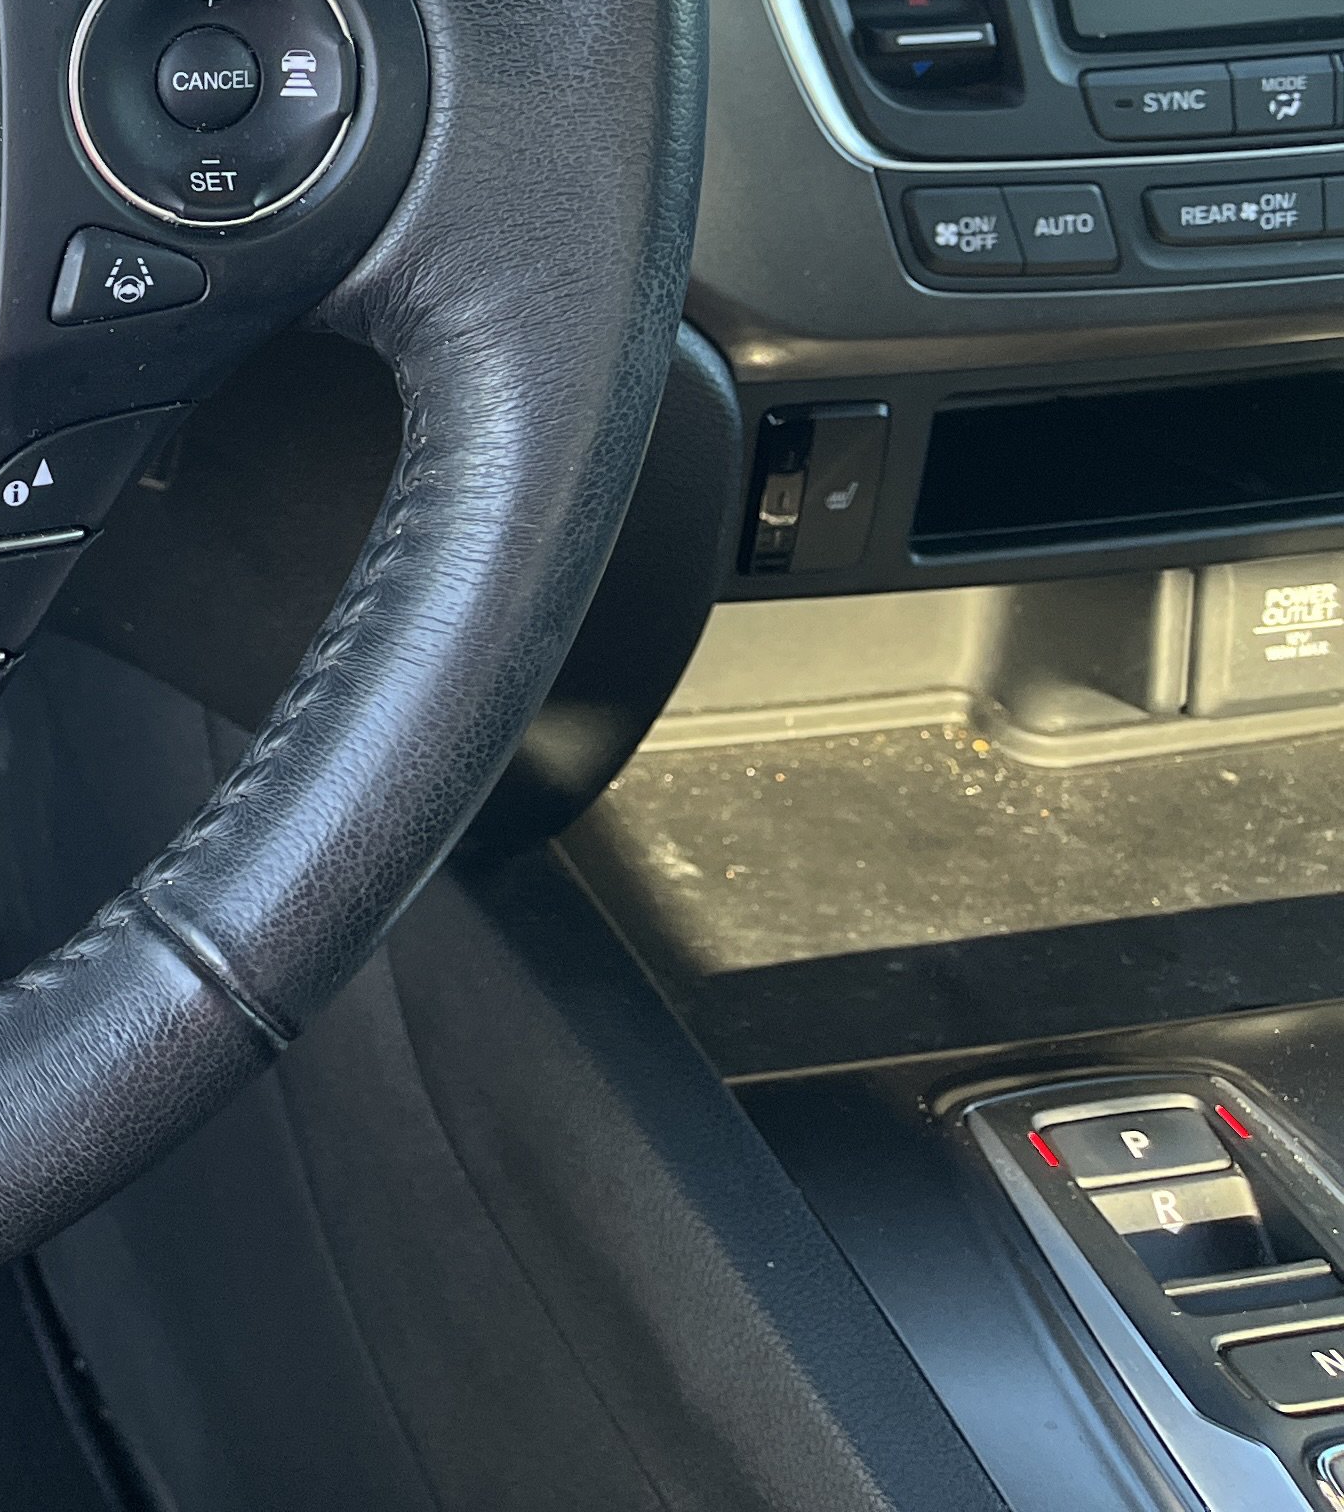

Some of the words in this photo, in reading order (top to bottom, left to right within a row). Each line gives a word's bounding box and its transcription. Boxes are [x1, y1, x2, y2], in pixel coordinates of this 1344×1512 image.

[171, 71, 256, 92] CANCEL
[1261, 76, 1308, 92] MODE
[1142, 89, 1207, 113] SYNC
[189, 170, 238, 194] SET
[1034, 213, 1095, 237] AUTO
[1180, 203, 1237, 227] REAR
[1259, 210, 1299, 231] OFF
[958, 234, 998, 254] OFF
[1265, 583, 1337, 607] POWER
[1262, 602, 1340, 626] OUTLET
[1120, 1130, 1150, 1159] P
[1151, 1190, 1185, 1224] R
